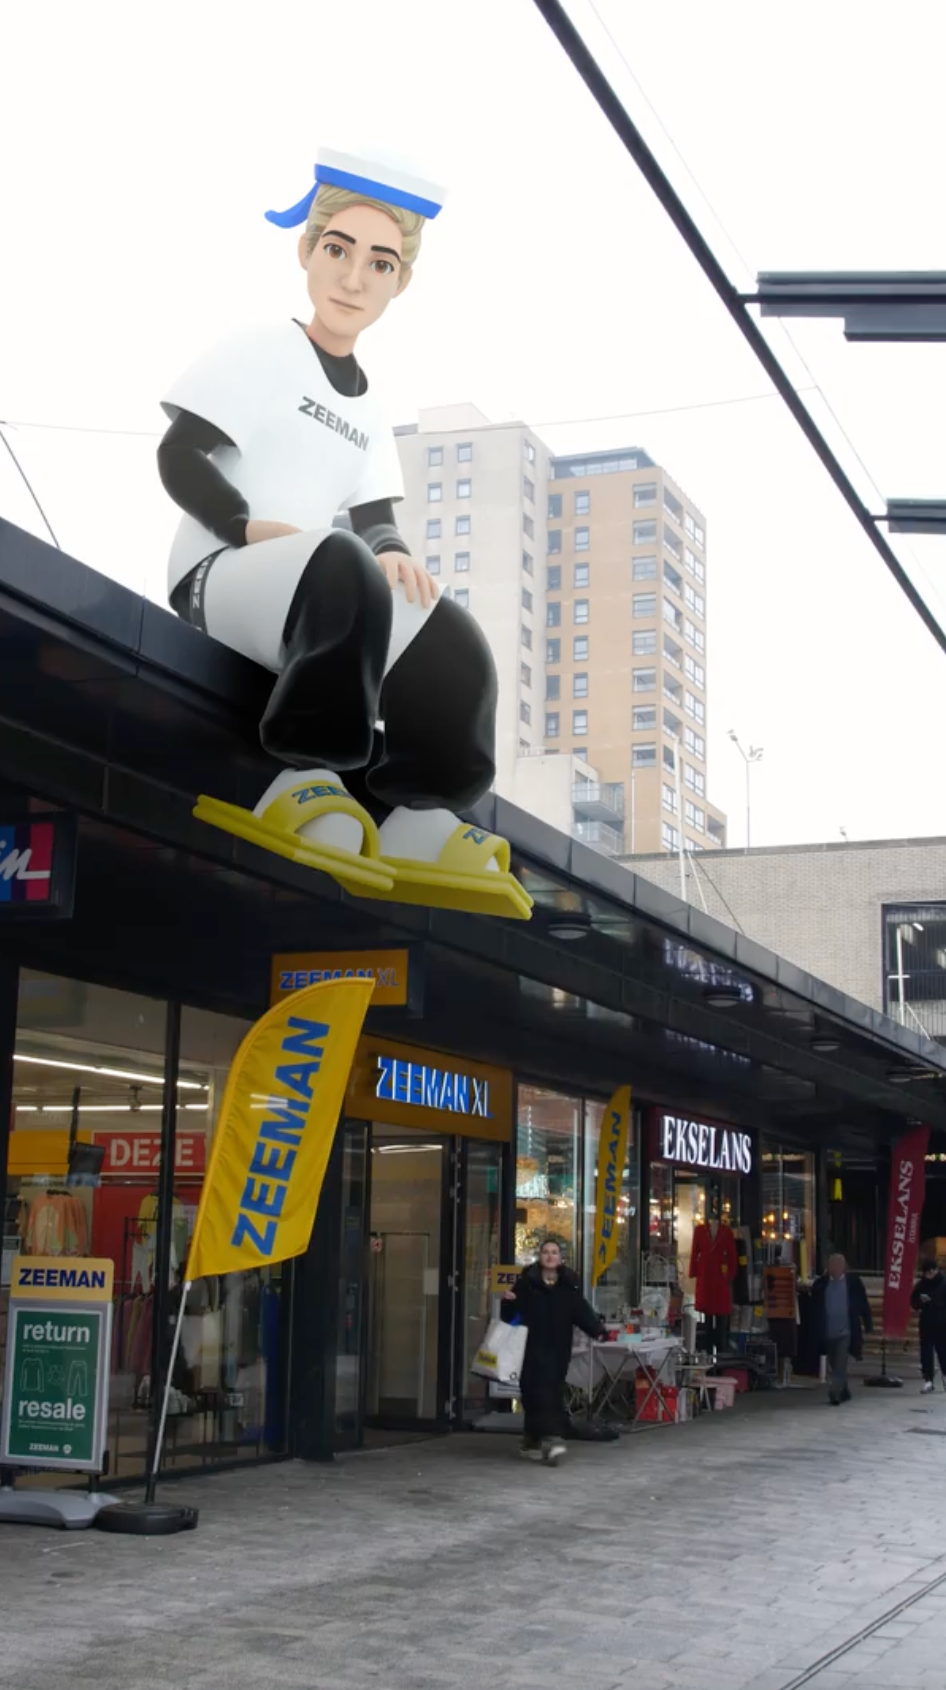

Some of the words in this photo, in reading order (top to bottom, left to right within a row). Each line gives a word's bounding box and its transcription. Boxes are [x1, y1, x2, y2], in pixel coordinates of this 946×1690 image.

[298, 395, 369, 451] ZEEMAN
[376, 967, 401, 987] XL
[376, 1056, 470, 1114] ZEEMAN
[471, 1077, 494, 1119] XL
[230, 1016, 330, 1256] ZEEMAN
[663, 1115, 752, 1174] EKSELANS
[888, 1159, 914, 1289] EKSELANS
[18, 1268, 105, 1289] ZEEMAN
[23, 1321, 91, 1343] return
[18, 1398, 86, 1420] resale
[29, 1443, 59, 1452] ZEEMAN
